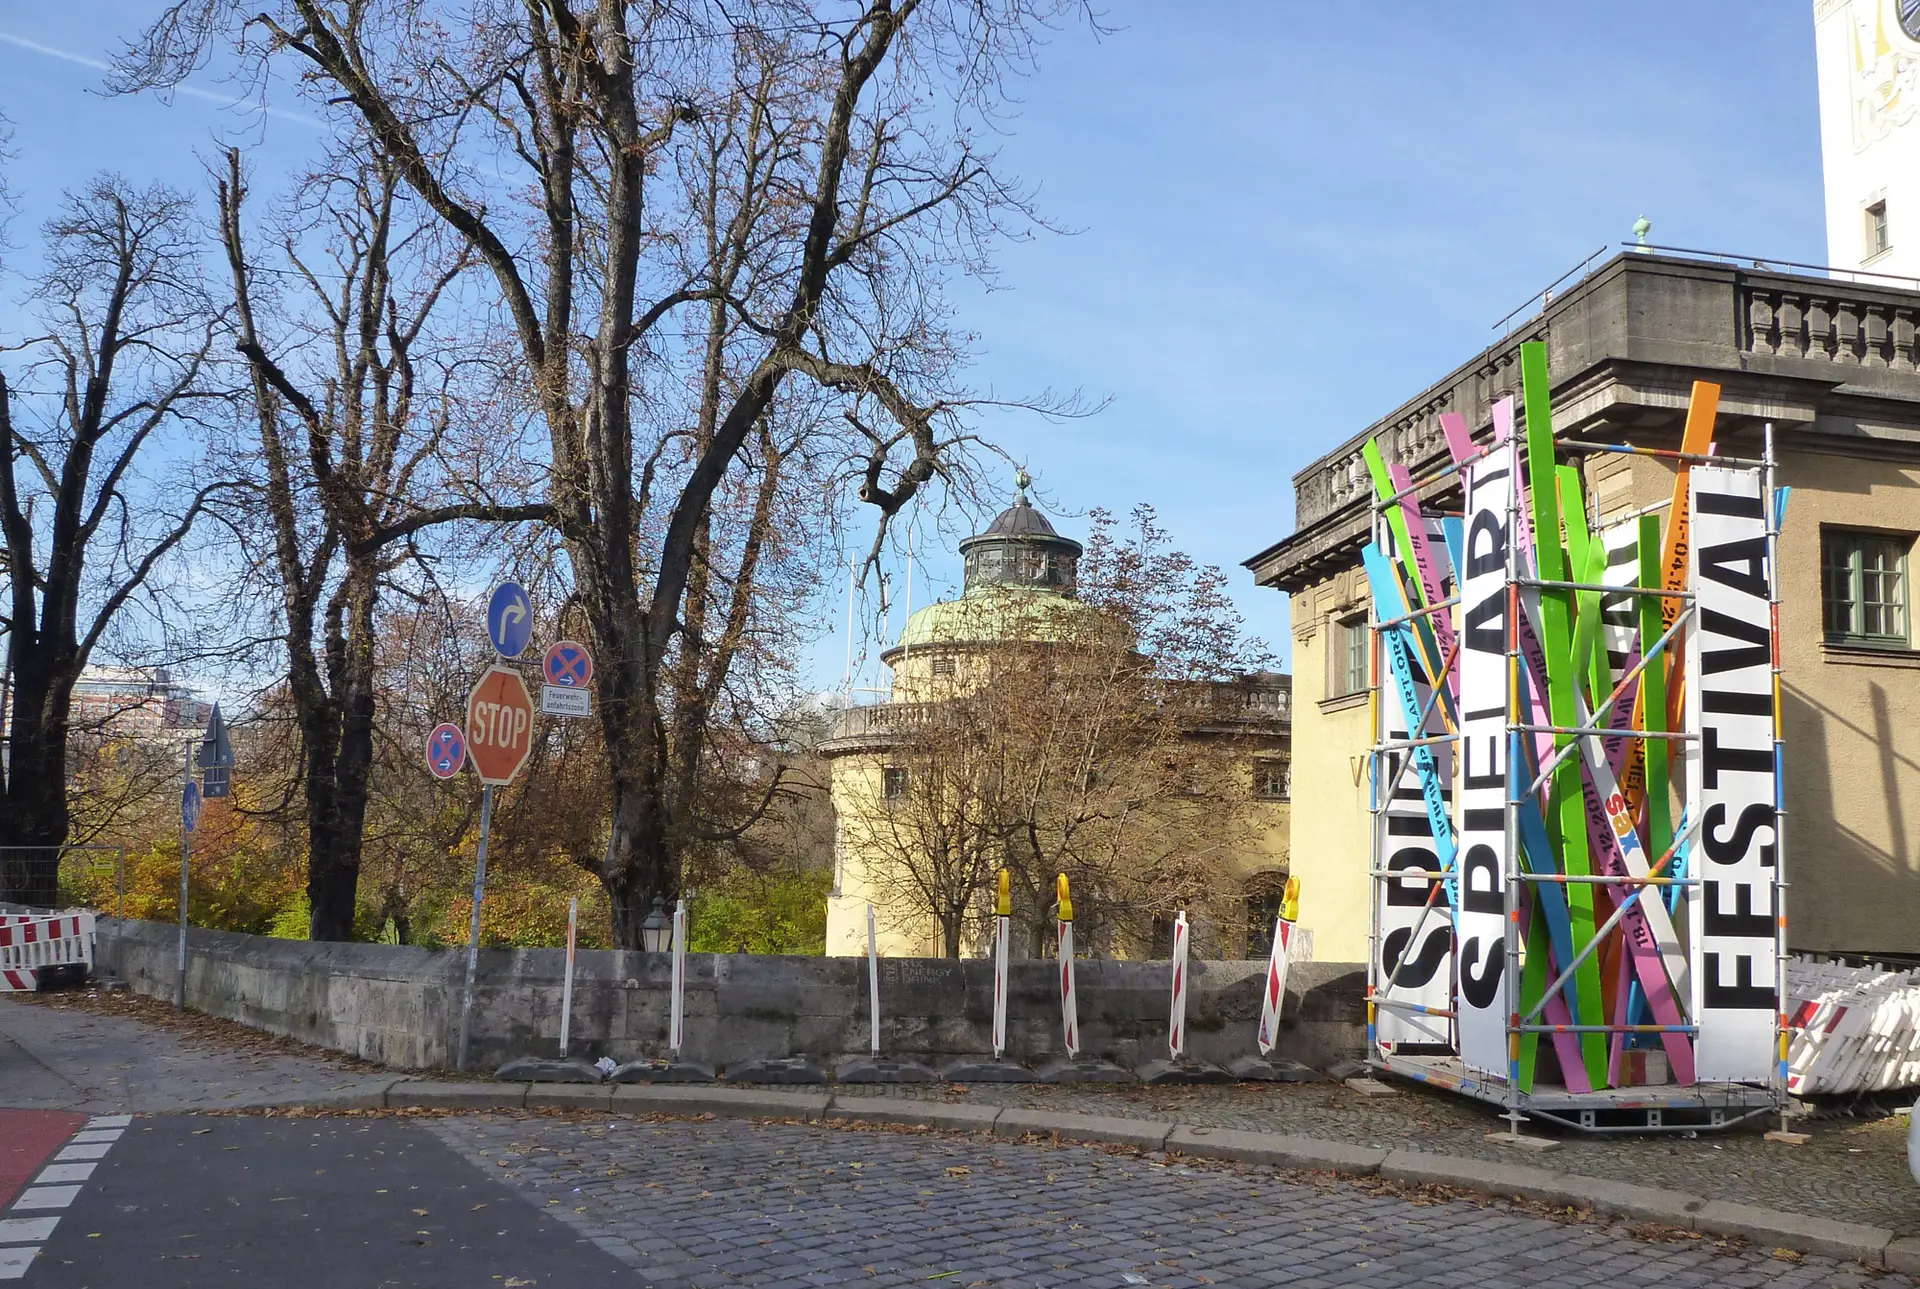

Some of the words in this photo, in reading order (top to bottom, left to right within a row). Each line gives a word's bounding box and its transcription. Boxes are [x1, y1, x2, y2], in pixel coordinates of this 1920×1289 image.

[548, 690, 583, 701] Feuerwehr-
[546, 700, 585, 713] anfahrtszone
[473, 701, 527, 749] STOP
[1695, 489, 1776, 1009] FESTIVAL
[1606, 793, 1640, 857] sax
[902, 967, 953, 977] ENERGY
[902, 976, 941, 984] DRINK
